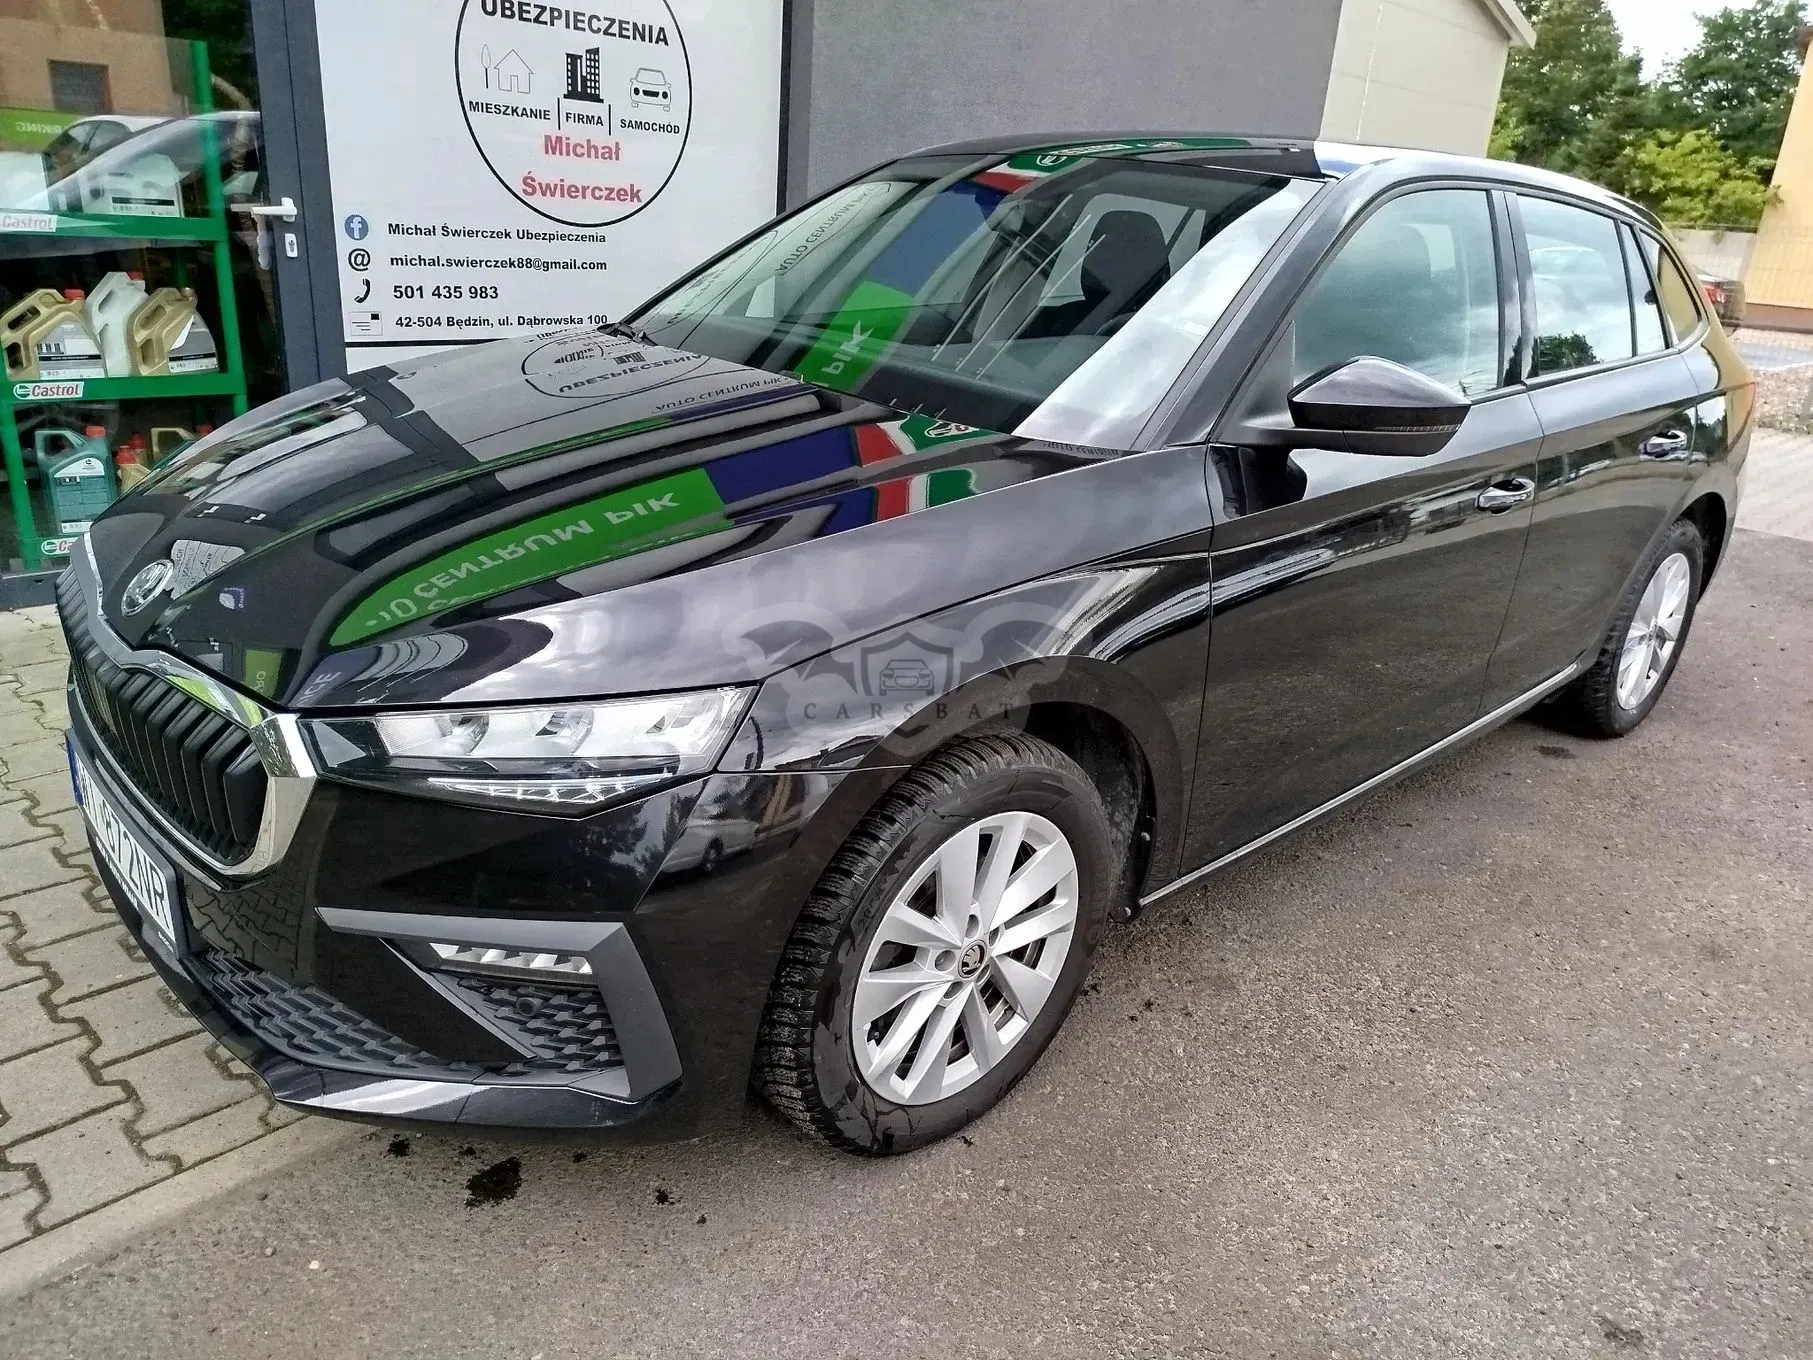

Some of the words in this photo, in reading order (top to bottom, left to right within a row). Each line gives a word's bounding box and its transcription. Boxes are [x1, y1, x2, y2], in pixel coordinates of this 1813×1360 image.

[481, 0, 669, 46] UBEZPIECZENIA
[469, 100, 551, 121] MIESZKANIE
[565, 112, 604, 127] FIRMA
[620, 117, 681, 135] SAMOCHÓD
[543, 134, 621, 161] Michał
[522, 171, 643, 203] Świerczek
[2, 215, 53, 230] Castrol
[387, 222, 437, 237] Michał
[441, 222, 513, 240] Świerczek
[516, 229, 607, 243] Ubezpieczenia
[390, 255, 608, 271] michal.swierczek88@gmail.com
[393, 285, 424, 299] 501
[431, 285, 463, 299] 435
[468, 285, 499, 299] 983
[395, 316, 442, 328] 42-504
[446, 316, 494, 330] Będzin,
[497, 315, 513, 327] ul.
[517, 315, 584, 328] Dąbrowska
[587, 314, 608, 325] 100
[31, 384, 79, 397] Castrol
